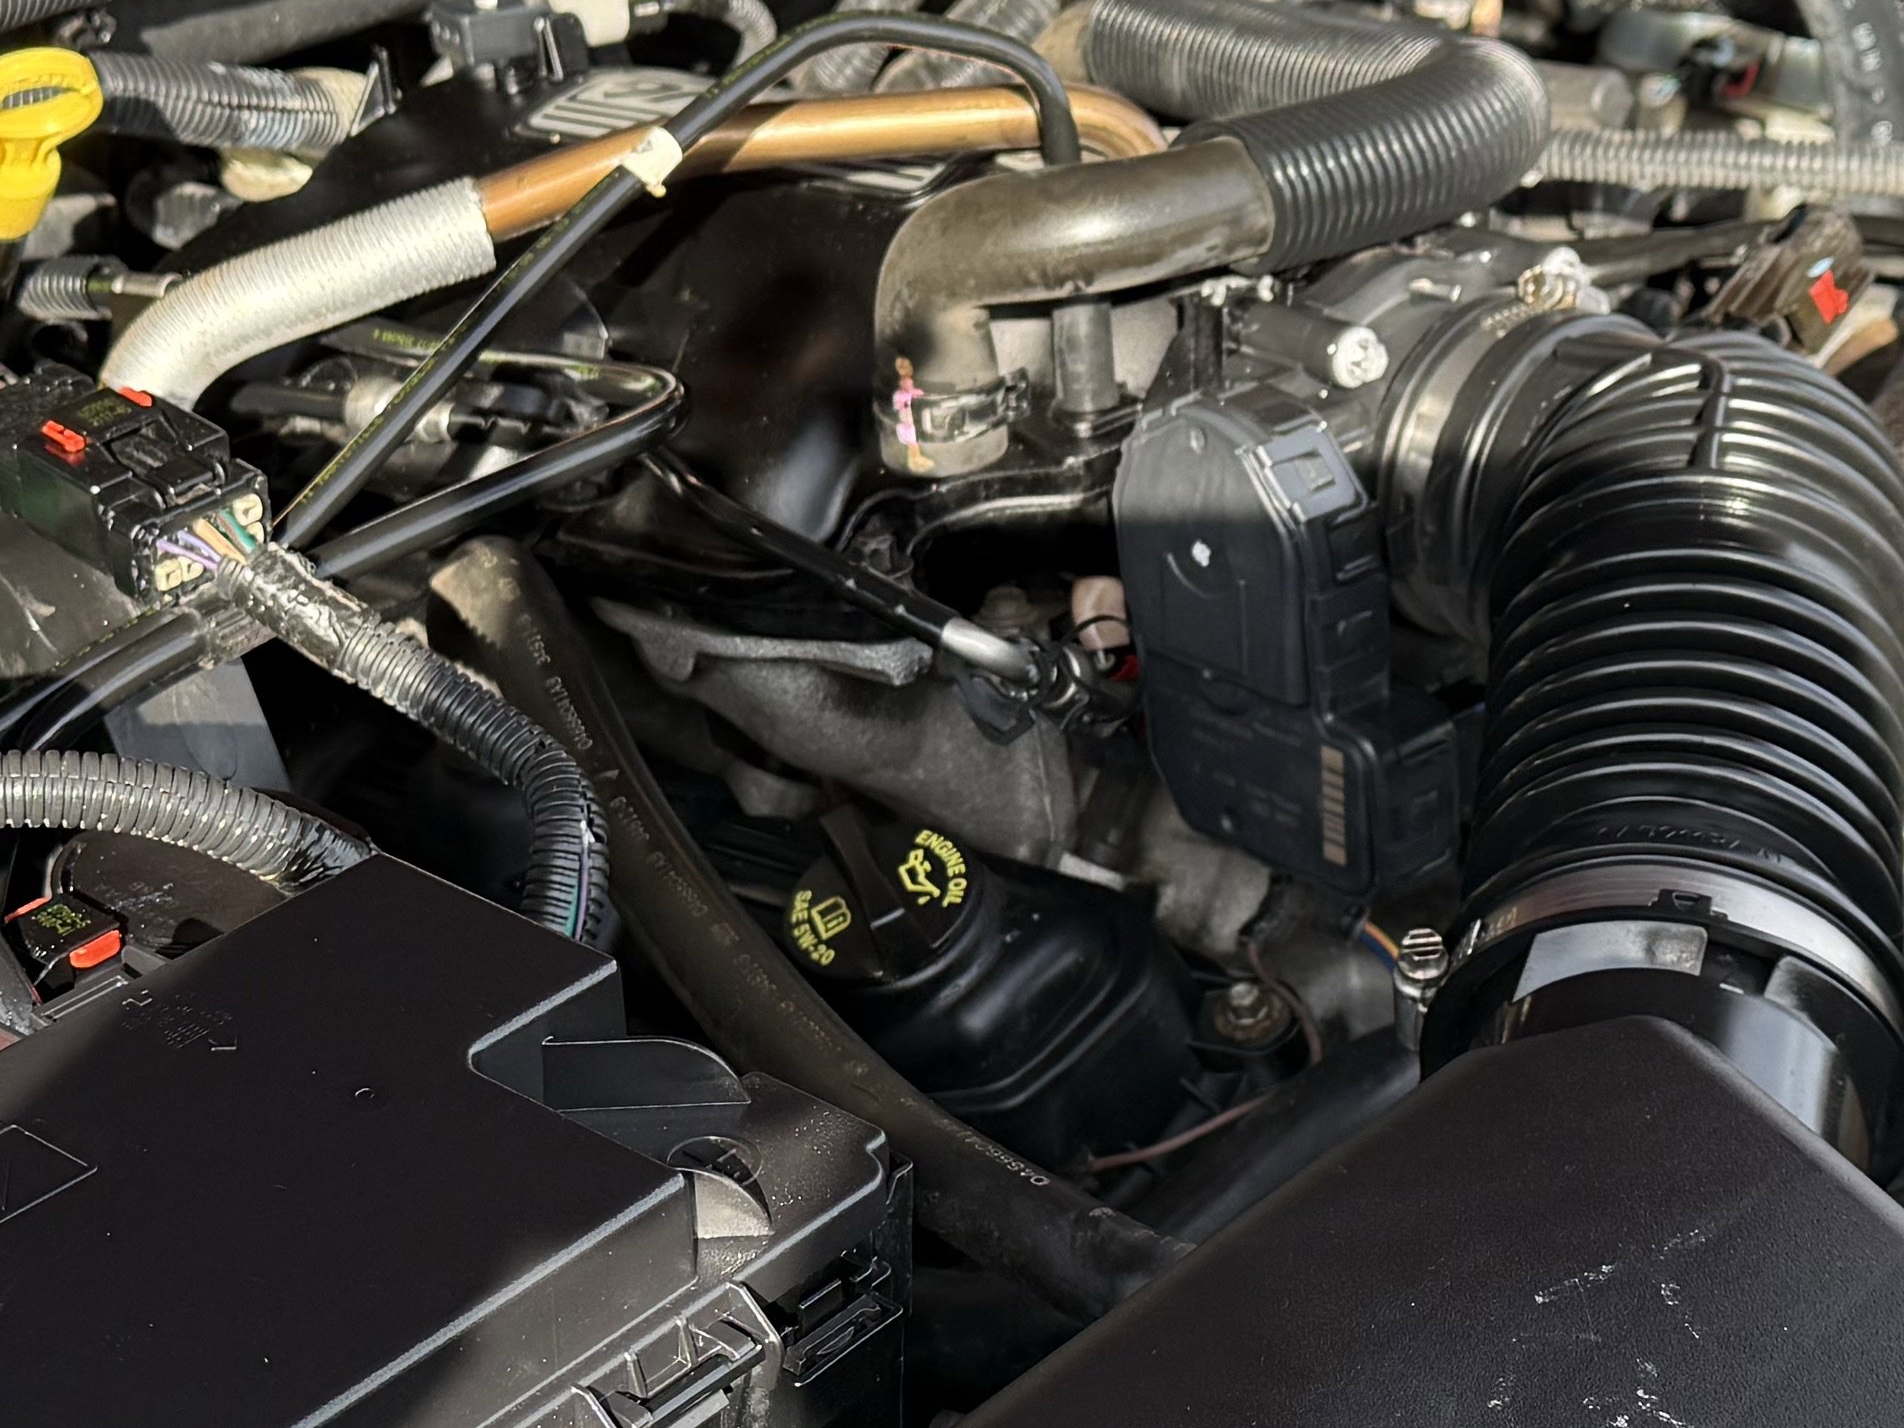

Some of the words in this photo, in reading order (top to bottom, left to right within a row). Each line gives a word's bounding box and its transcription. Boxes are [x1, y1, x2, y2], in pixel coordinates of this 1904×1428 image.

[914, 829, 966, 877] ENGINE
[942, 877, 968, 908] OIL
[792, 890, 813, 923] SAE
[793, 923, 835, 966] 5W-20
